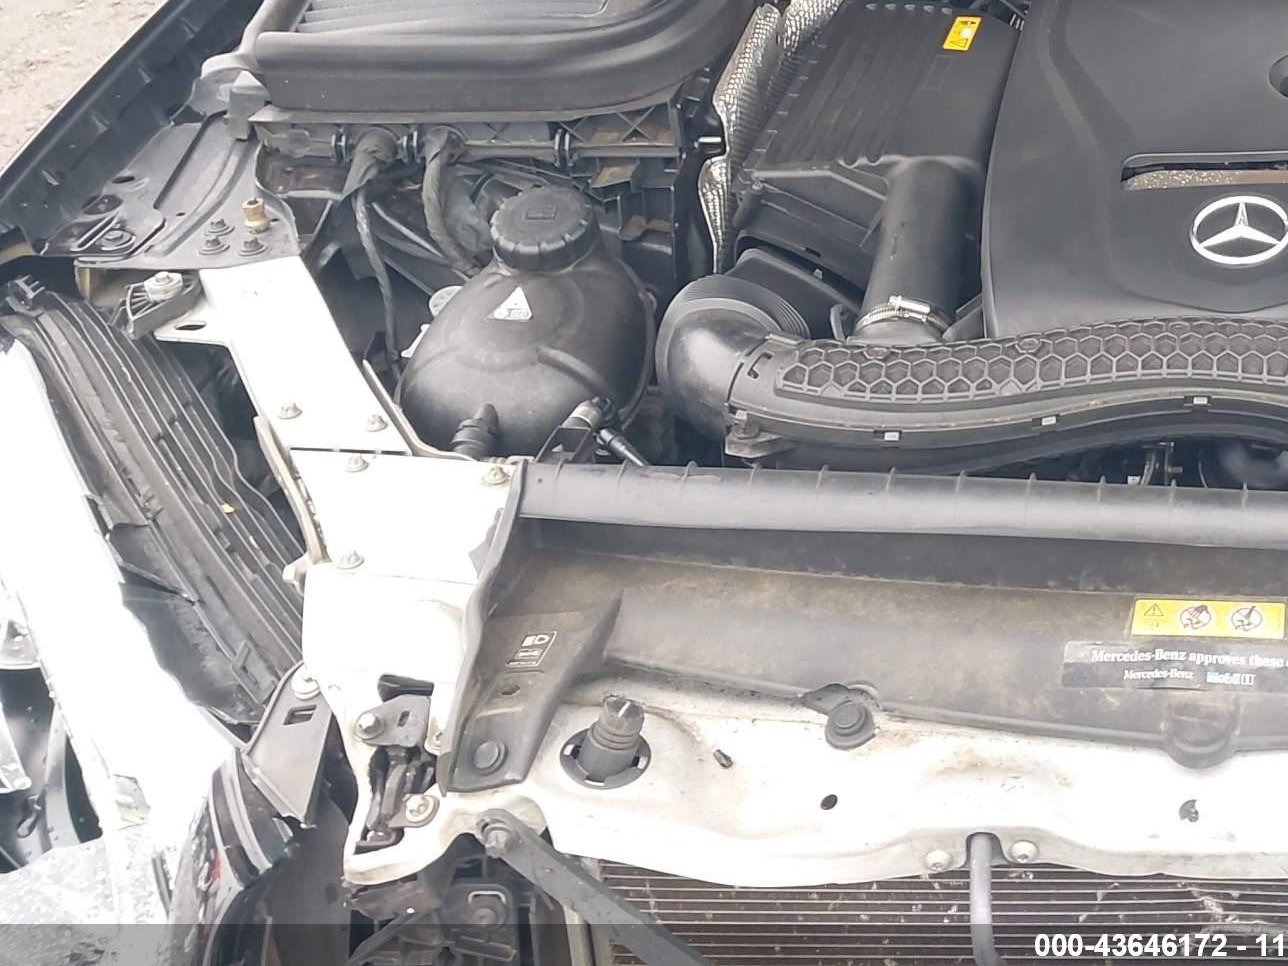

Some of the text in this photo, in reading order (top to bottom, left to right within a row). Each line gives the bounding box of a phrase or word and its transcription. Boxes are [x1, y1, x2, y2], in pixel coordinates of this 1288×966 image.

[1091, 648, 1187, 662] Mercedes-Benz
[1188, 652, 1246, 666] approves
[1248, 654, 1284, 667] these
[1123, 668, 1194, 679] Mercedes-Benz
